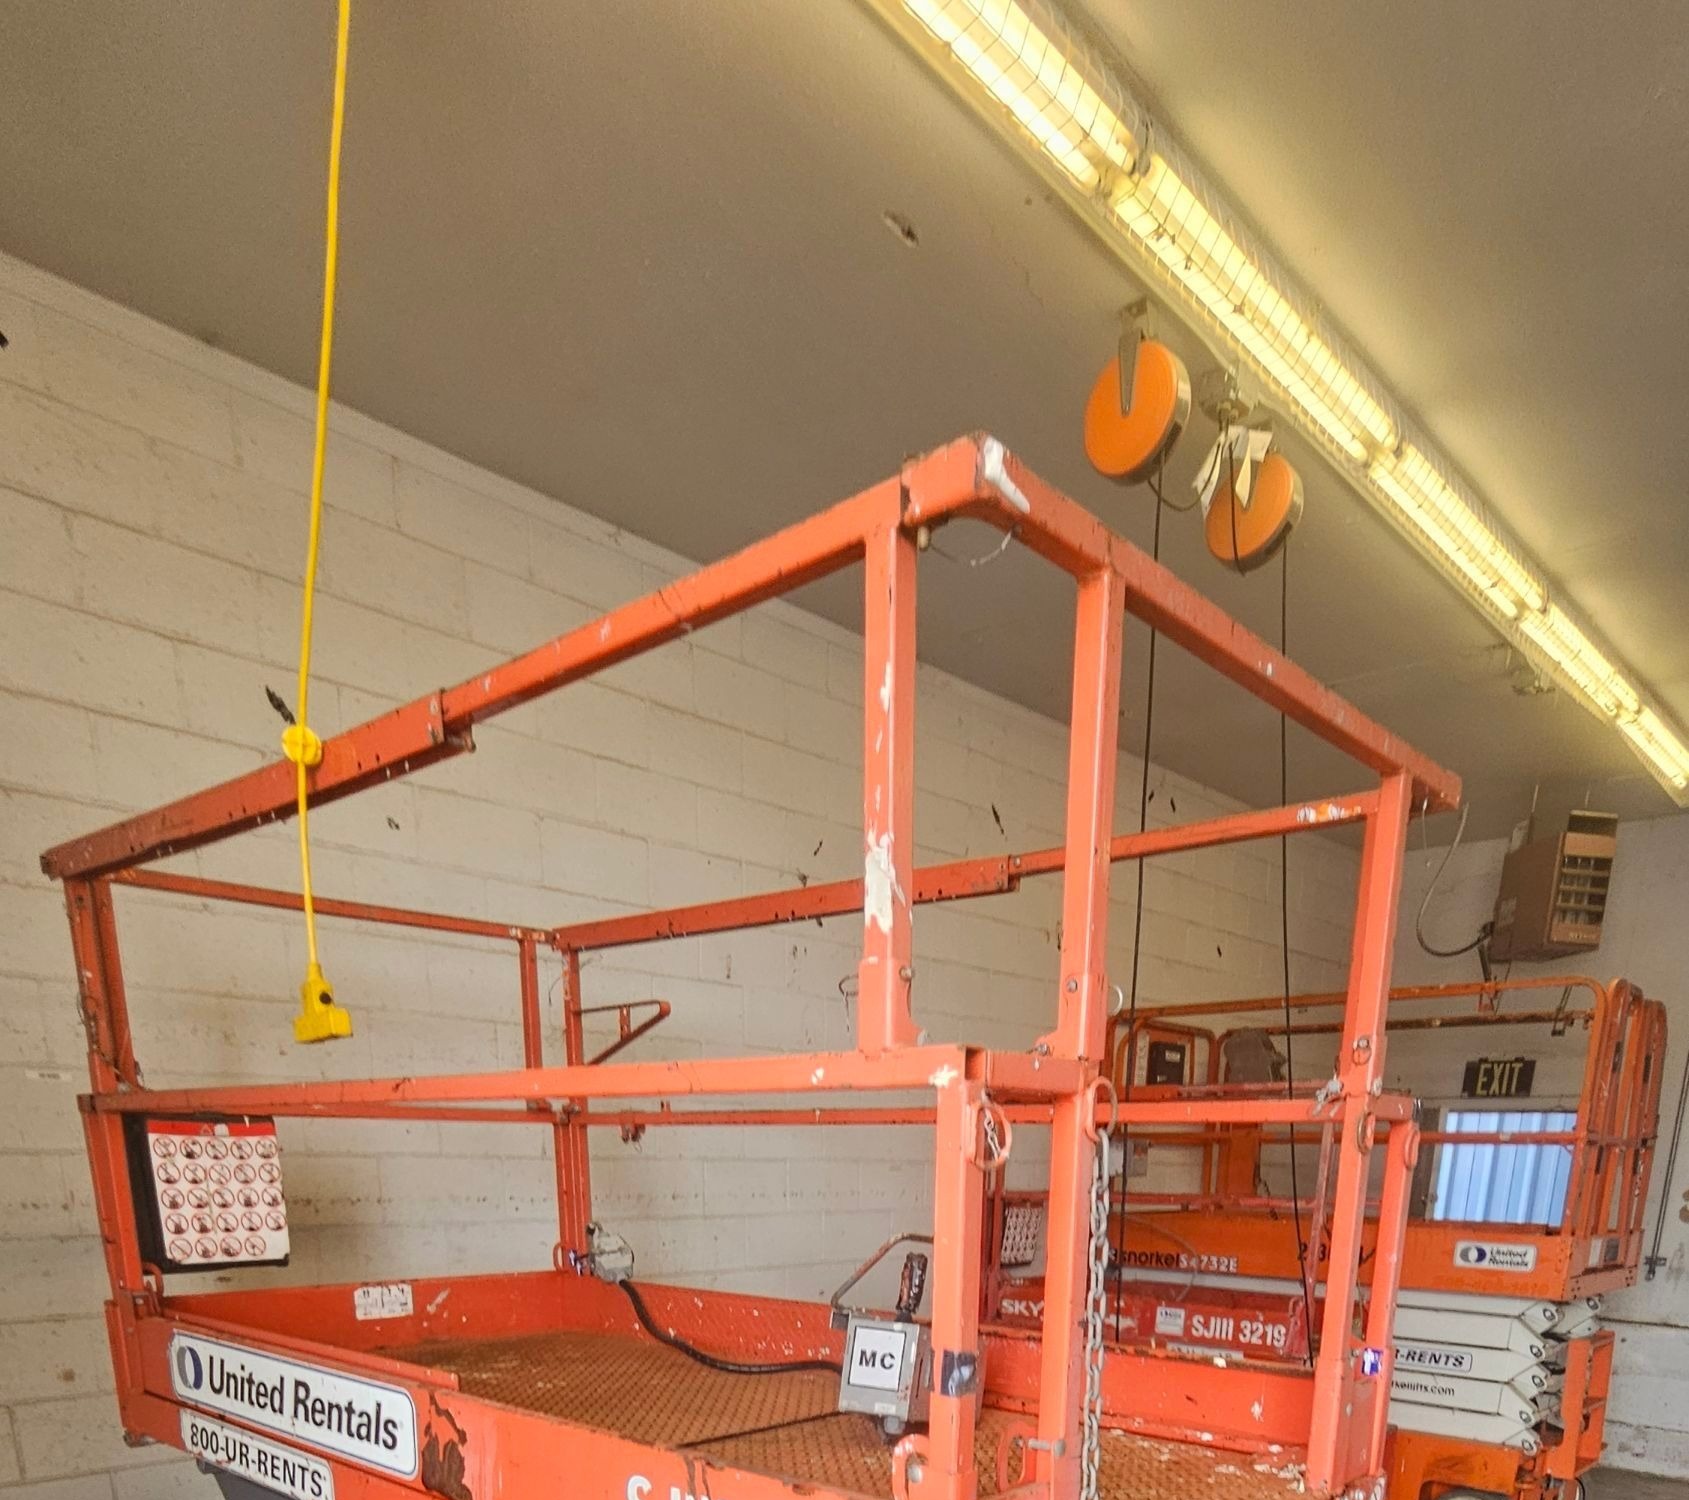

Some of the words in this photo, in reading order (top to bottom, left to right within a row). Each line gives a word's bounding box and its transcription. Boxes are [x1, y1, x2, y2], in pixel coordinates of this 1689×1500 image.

[1476, 1062, 1524, 1096] EXIT
[859, 1348, 896, 1370] MC
[209, 1355, 285, 1415] United
[294, 1378, 399, 1451] Rentals
[190, 1422, 324, 1497] 800-UR-RENTS
